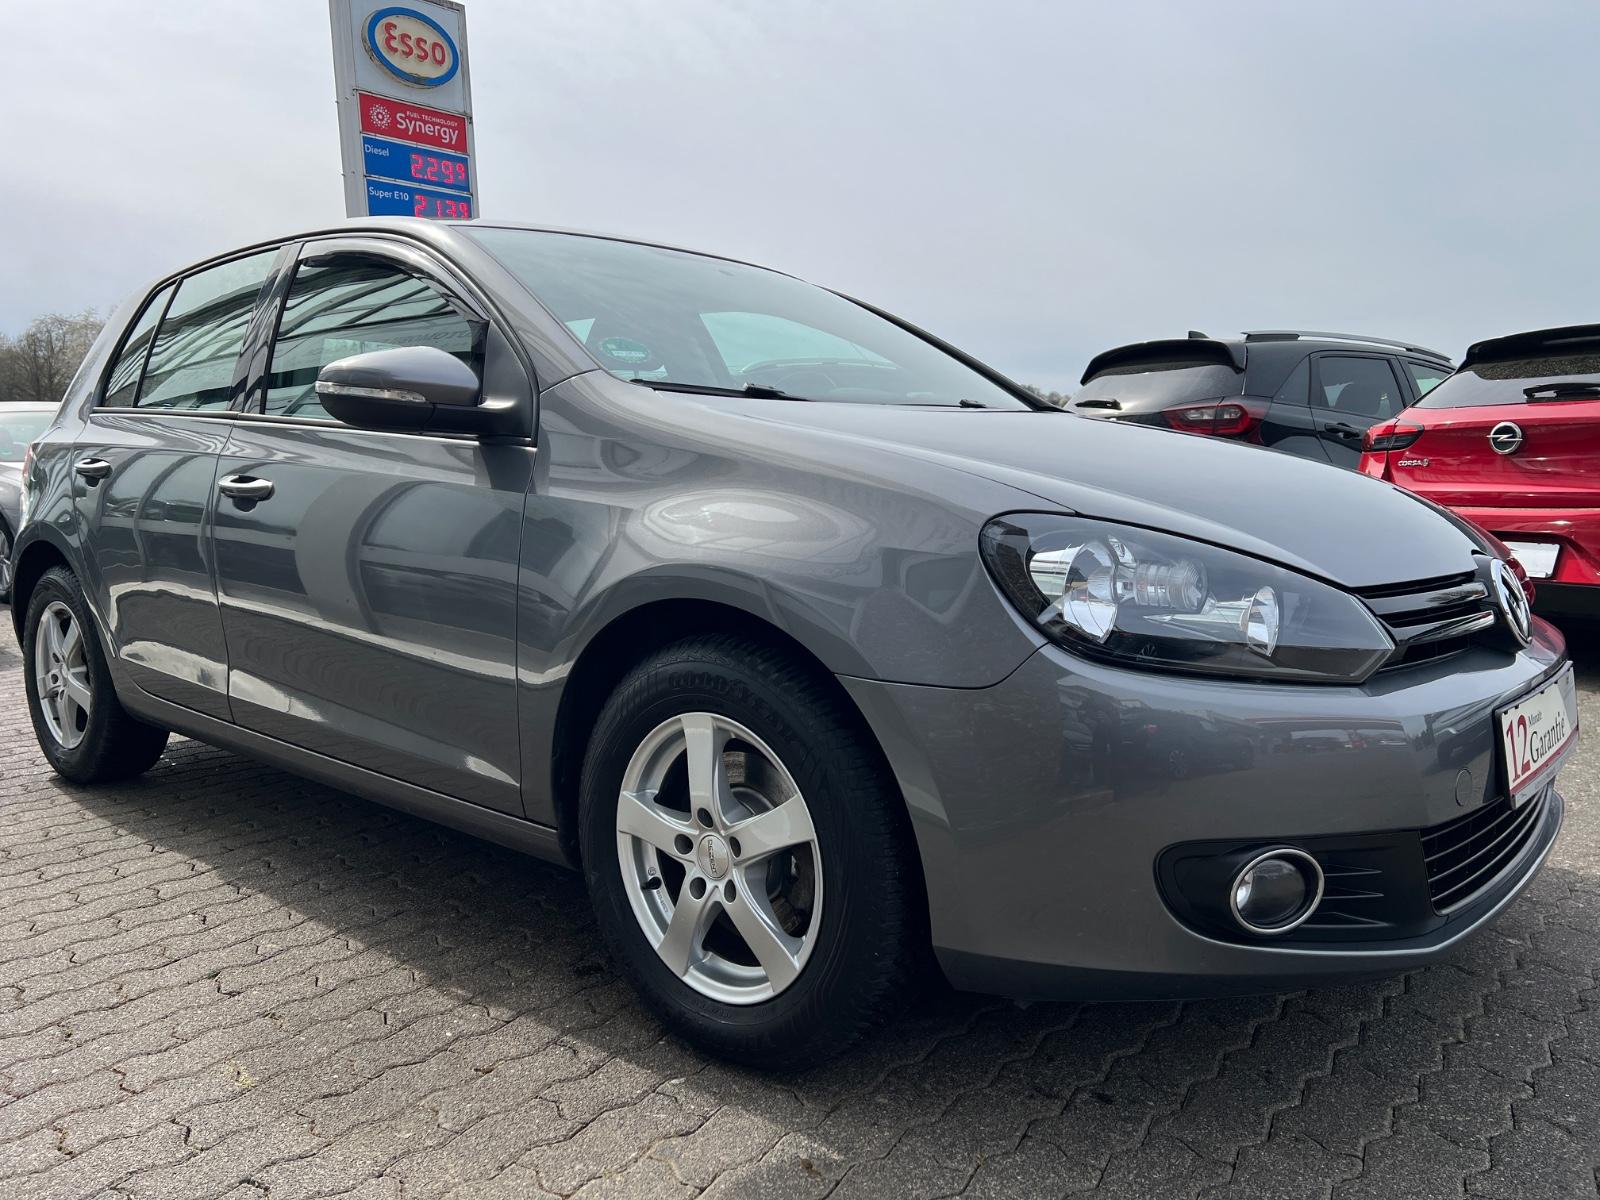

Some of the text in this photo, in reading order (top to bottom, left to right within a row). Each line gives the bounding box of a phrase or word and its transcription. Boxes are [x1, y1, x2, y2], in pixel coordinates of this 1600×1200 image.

[396, 113, 459, 145] Synergy
[406, 110, 458, 127] FUEL TECHNOLOGY
[364, 144, 389, 157] Diesel
[368, 187, 409, 201] Super E10
[1506, 714, 1531, 783] 12
[1530, 711, 1565, 763] Garantie
